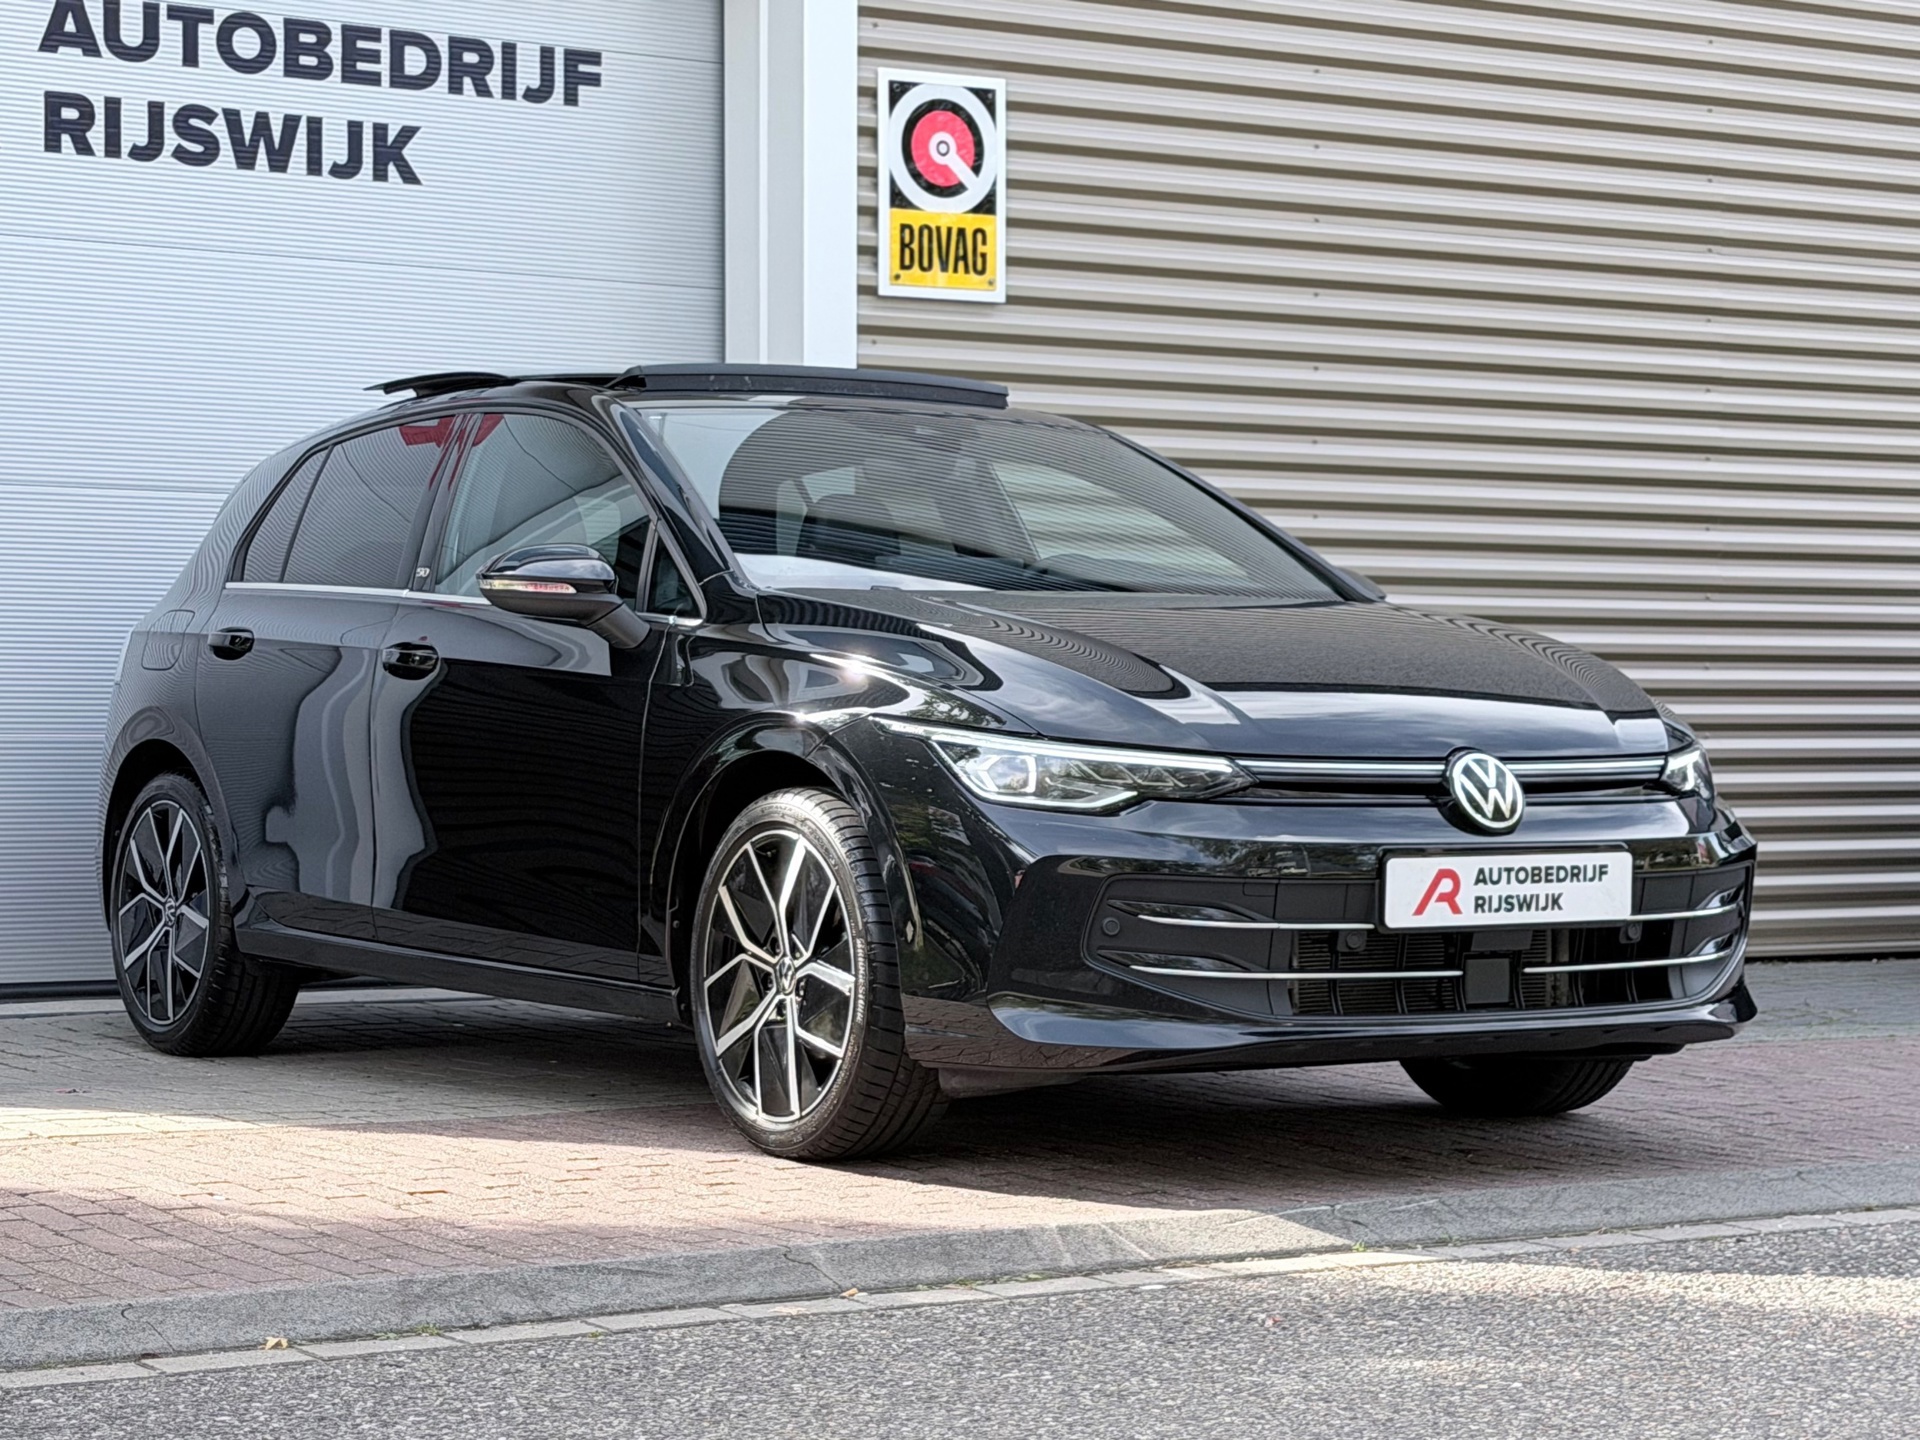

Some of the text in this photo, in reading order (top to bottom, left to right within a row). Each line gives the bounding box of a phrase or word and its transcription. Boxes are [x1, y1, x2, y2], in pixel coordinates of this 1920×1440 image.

[38, 0, 602, 106] AUTOBEDRIJF
[43, 90, 423, 186] RIJSWIJK
[899, 223, 988, 276] BOVAG
[1473, 864, 1609, 886] AUTOBEDRIJF
[1473, 892, 1564, 914] RIJSWIJK
